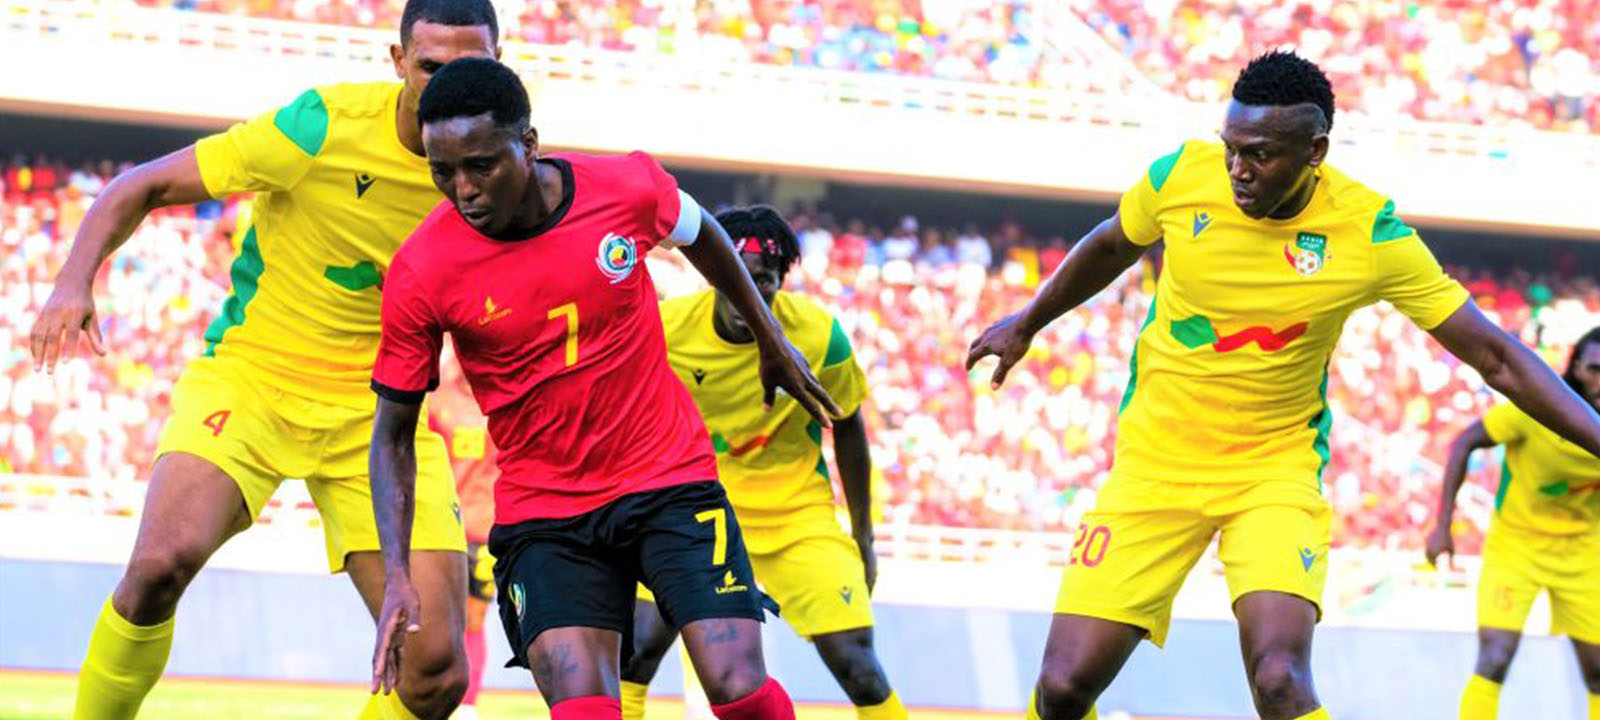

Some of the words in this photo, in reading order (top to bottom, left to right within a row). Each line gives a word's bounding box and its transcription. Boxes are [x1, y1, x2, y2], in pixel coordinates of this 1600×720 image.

[547, 302, 578, 368] 7
[203, 410, 231, 437] 4
[695, 508, 727, 566] 7
[1070, 523, 1112, 568] 20
